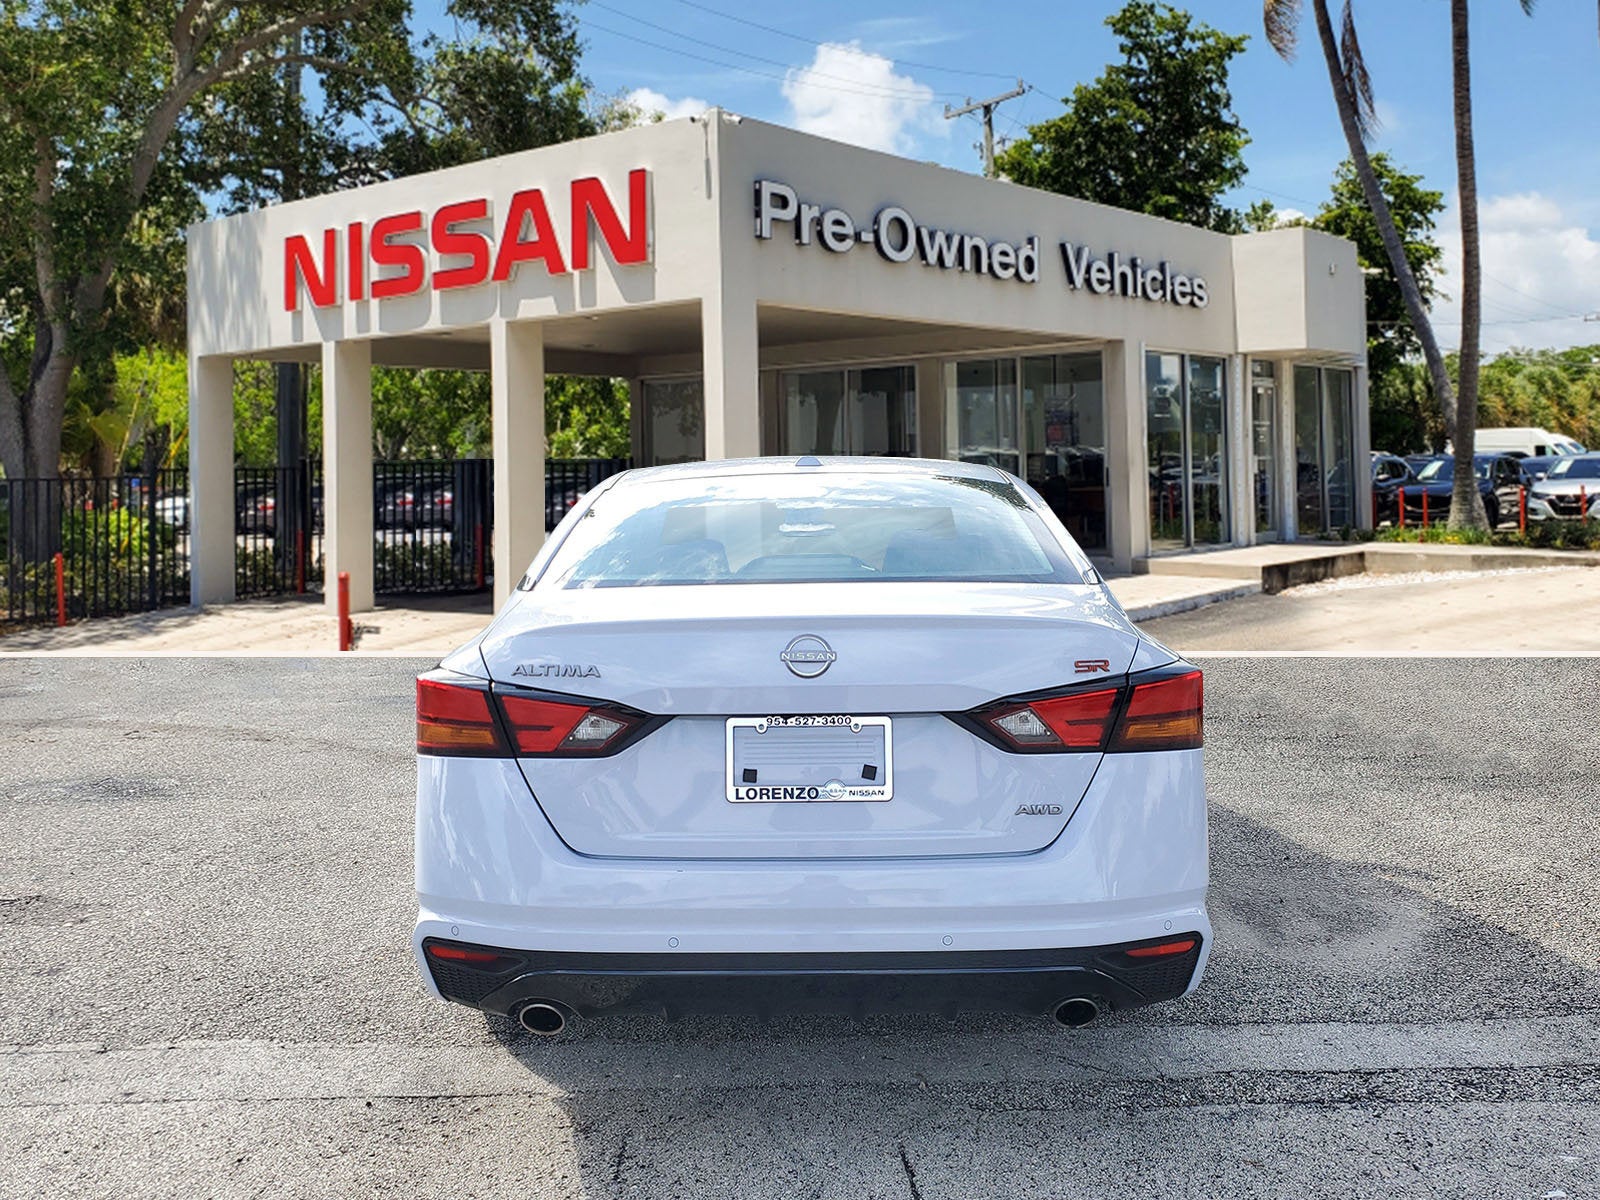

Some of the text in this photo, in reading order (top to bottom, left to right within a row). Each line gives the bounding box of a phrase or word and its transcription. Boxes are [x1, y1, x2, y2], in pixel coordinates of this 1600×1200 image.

[285, 169, 649, 312] NISSAN
[754, 180, 1209, 309] Pre-Owned Vehicles
[781, 651, 837, 661] NISSAN
[511, 664, 601, 678] ALTIMA
[1074, 659, 1110, 673] SR
[766, 716, 852, 726] 954-527-3400
[735, 787, 819, 800] LORENZO
[849, 789, 885, 797] NISSAN
[1015, 804, 1063, 815] AWD
